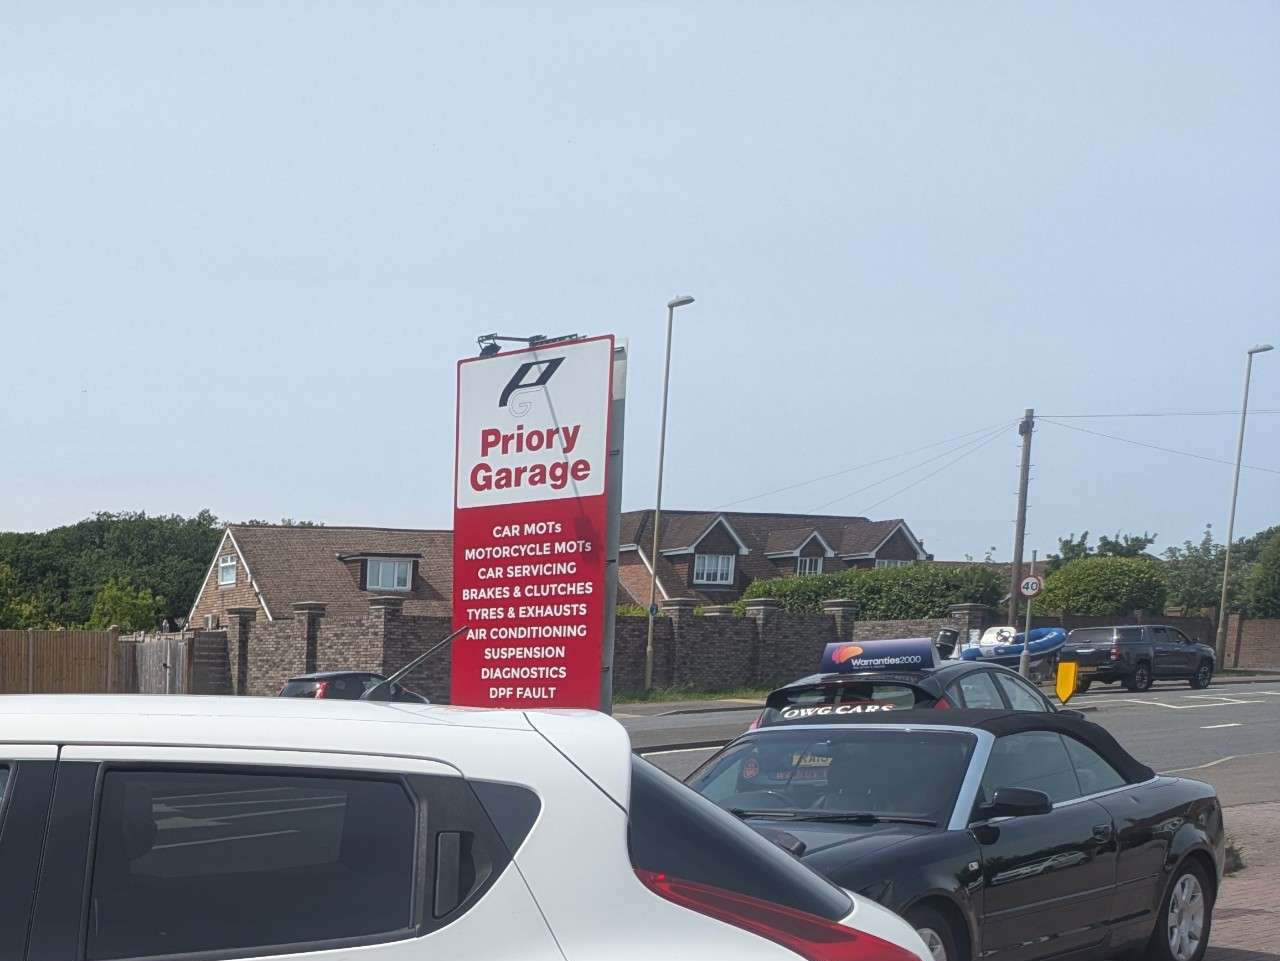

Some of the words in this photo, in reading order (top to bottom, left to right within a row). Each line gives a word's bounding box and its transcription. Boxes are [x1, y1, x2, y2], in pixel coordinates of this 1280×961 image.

[481, 424, 581, 457] Priory
[470, 459, 591, 492] Garage
[492, 525, 520, 538] CAR
[523, 521, 562, 536] MOTs
[465, 543, 551, 560] MOTORCYCLE
[554, 540, 592, 554] MOTs
[478, 567, 503, 580] CAR
[506, 562, 577, 578] SERVICING
[462, 586, 510, 600] BRAKES
[513, 585, 522, 598] &
[524, 582, 593, 597] CLUTCHES
[1022, 582, 1038, 591] 40
[466, 608, 504, 620] TYRES
[507, 607, 515, 619] &
[519, 604, 587, 618] EXHAUSTS
[466, 628, 487, 640] AIR
[490, 625, 587, 640] CONDITIONING
[484, 646, 565, 659] SUSPENSION
[851, 655, 922, 666] Warranties2000
[481, 667, 567, 679] DIAGNOSTICS
[489, 688, 513, 699] DPF
[516, 687, 556, 699] FAULT
